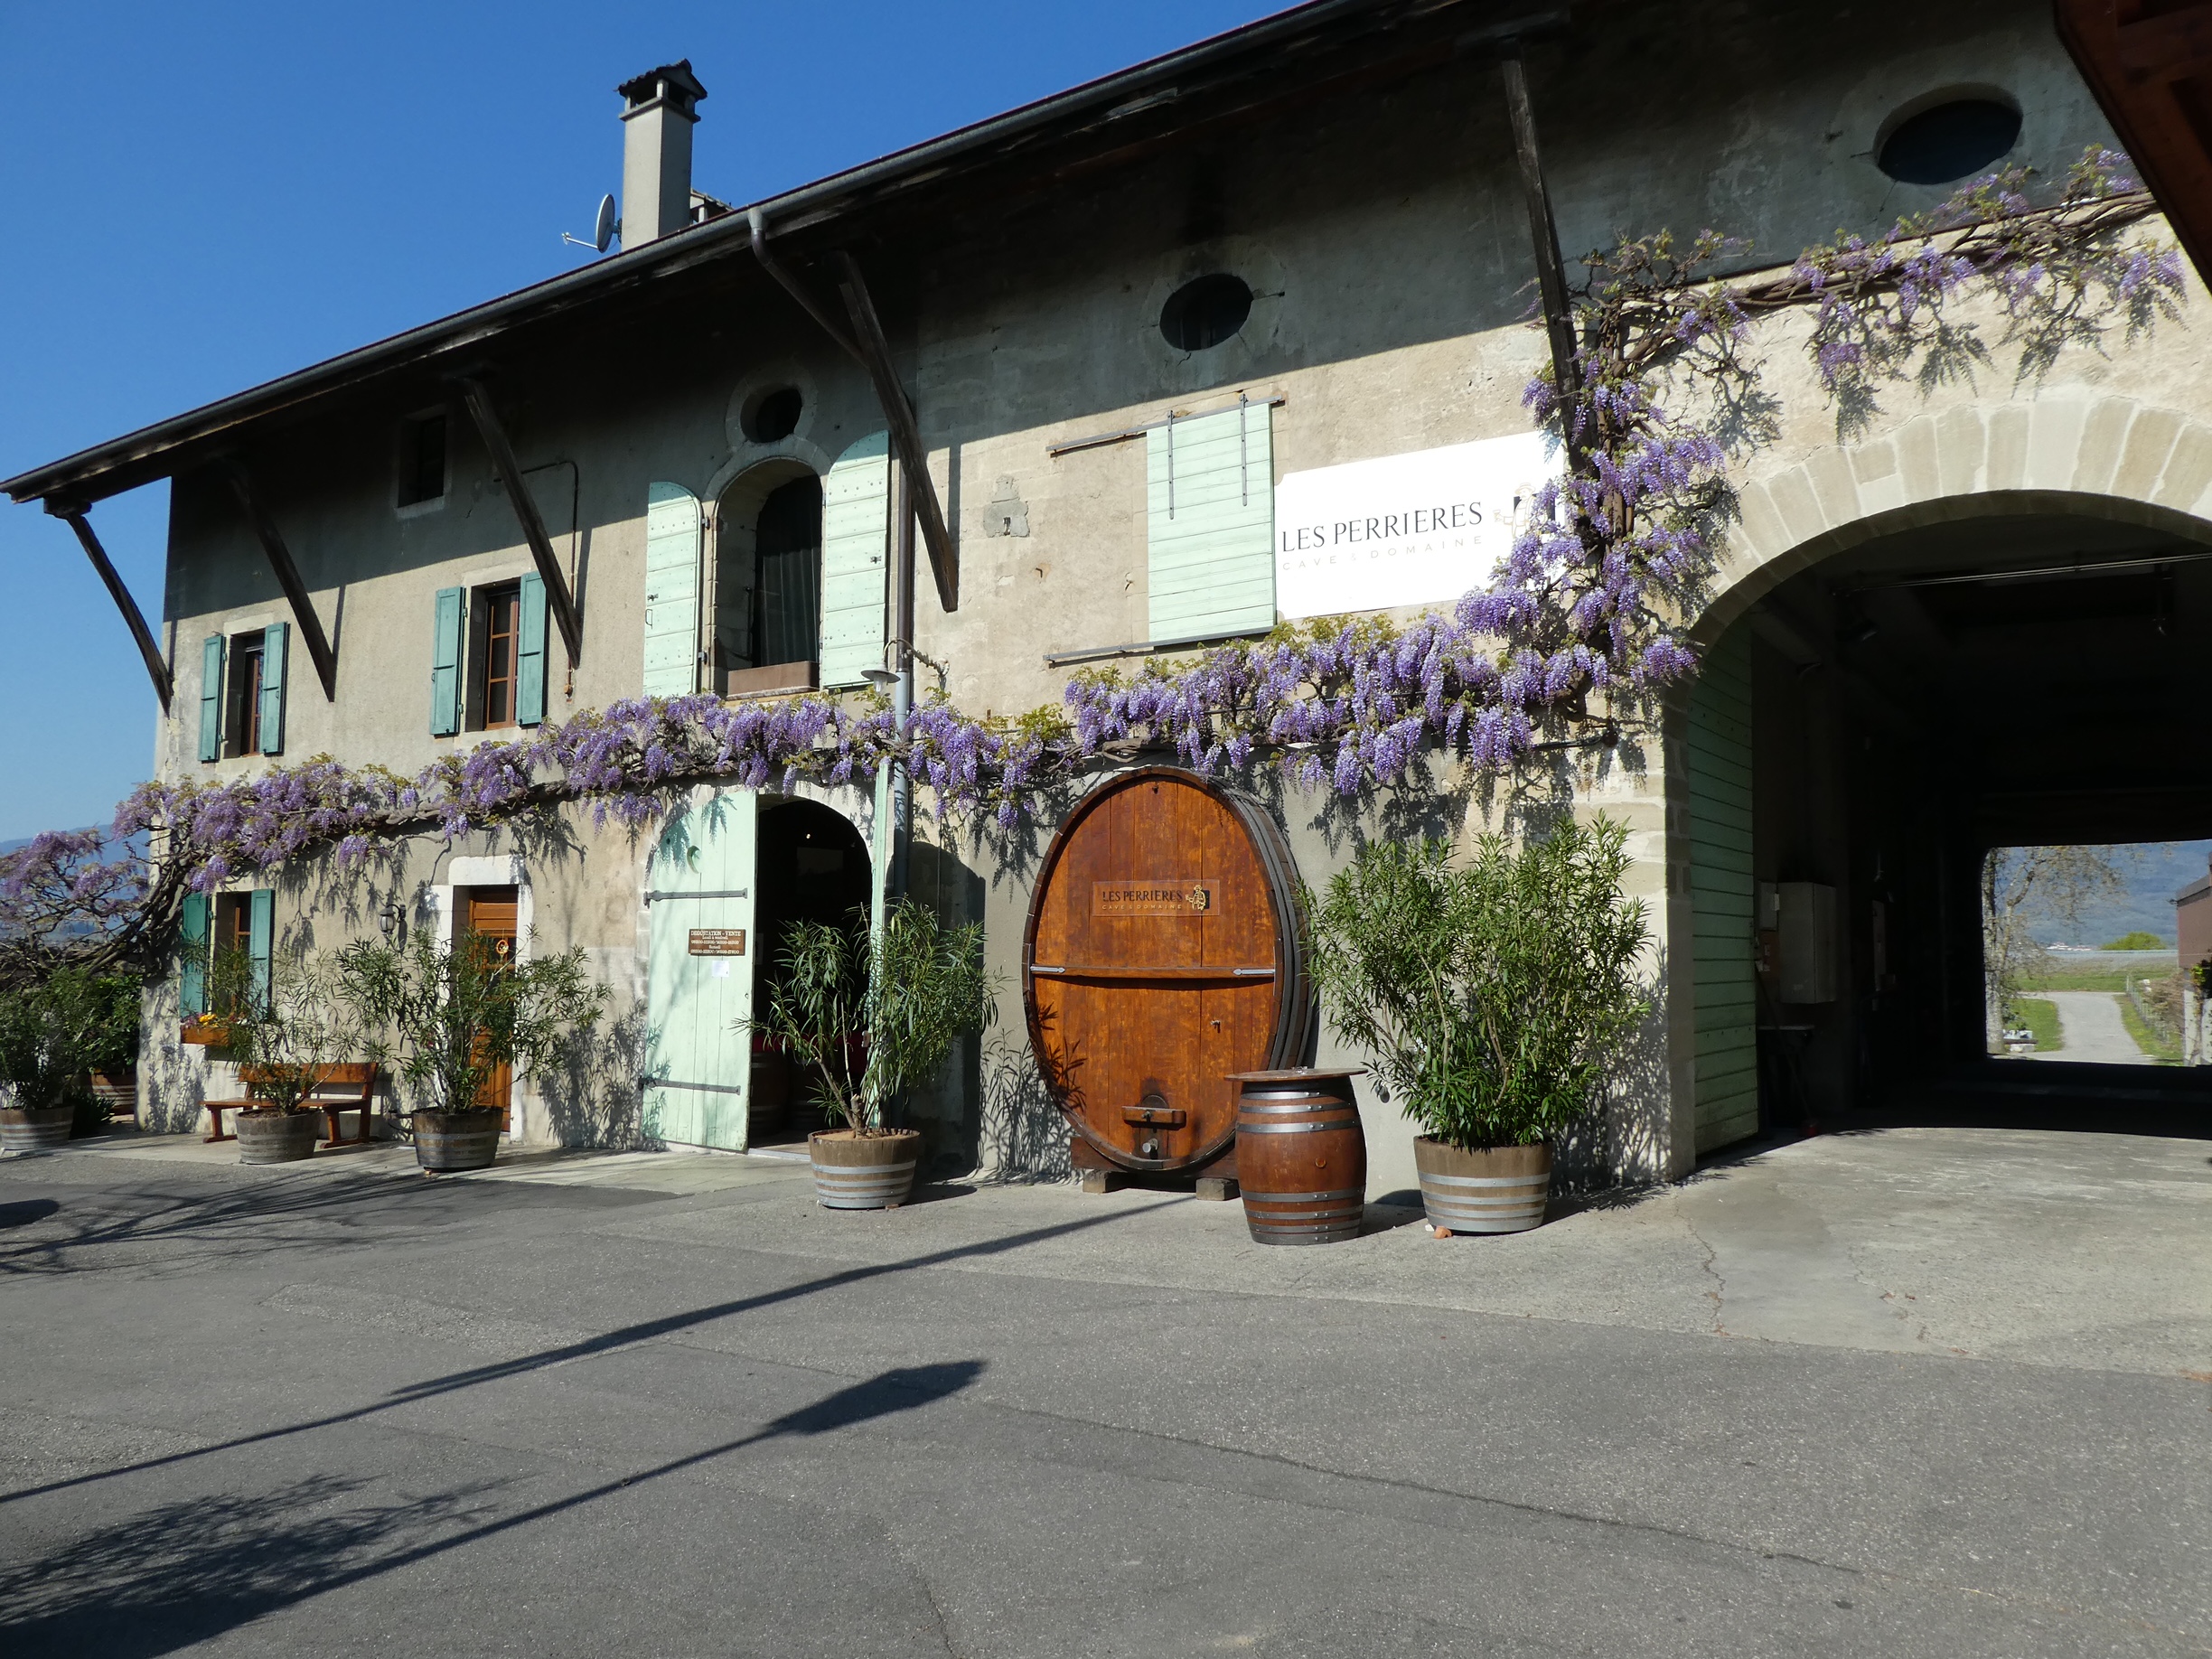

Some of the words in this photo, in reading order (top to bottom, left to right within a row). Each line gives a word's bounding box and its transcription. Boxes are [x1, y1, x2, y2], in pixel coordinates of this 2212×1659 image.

[1282, 525, 1326, 552] LES
[1334, 501, 1483, 545] PERRIERES
[1282, 555, 1337, 570] CAVE
[1349, 552, 1356, 561] &
[1371, 535, 1482, 558] DOMAINE
[1102, 890, 1120, 902] LES
[1123, 889, 1183, 902] PERRIERES
